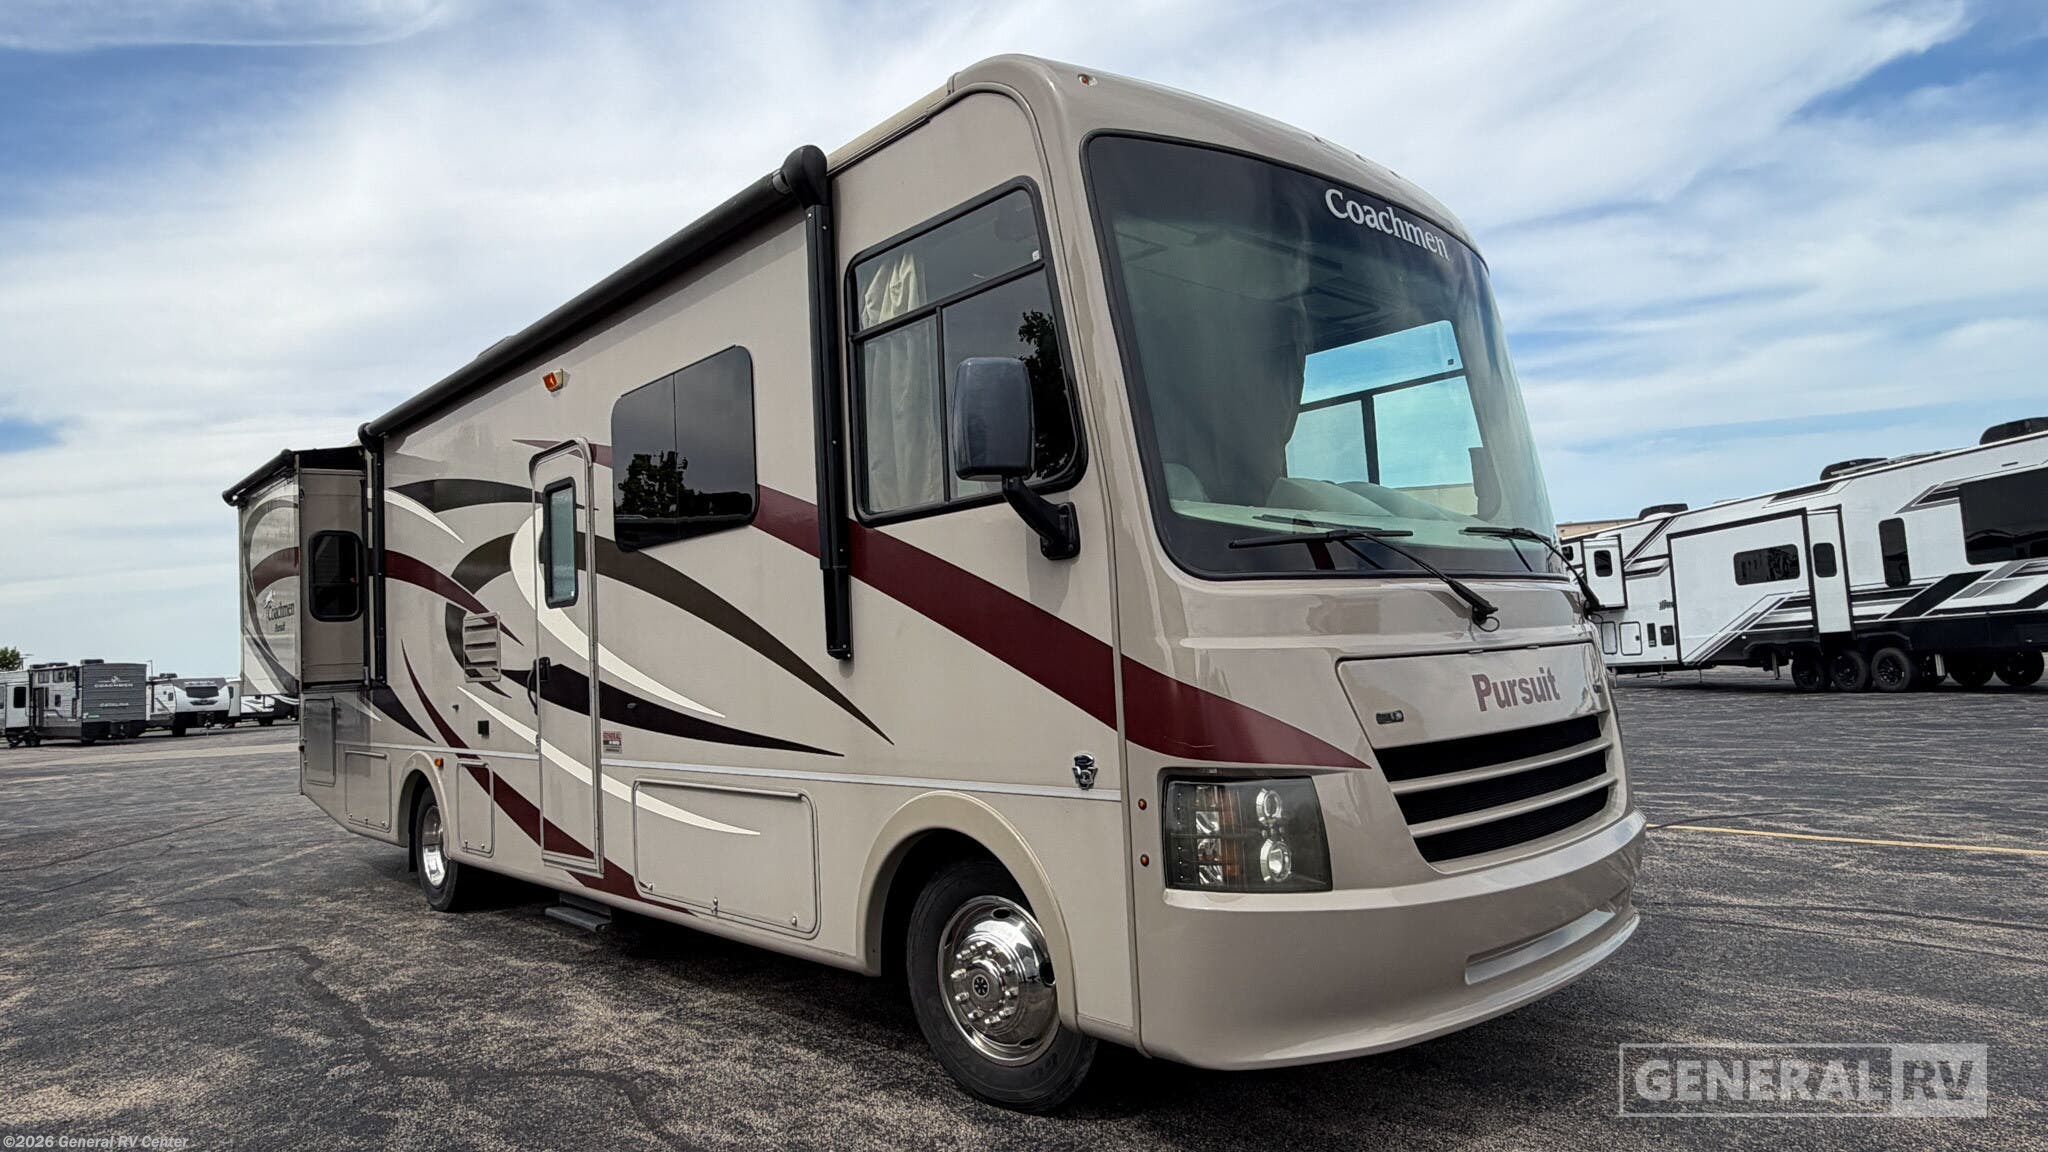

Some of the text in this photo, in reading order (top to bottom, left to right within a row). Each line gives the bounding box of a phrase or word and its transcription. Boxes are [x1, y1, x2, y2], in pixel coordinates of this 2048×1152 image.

[1325, 188, 1450, 261] Coachmen
[267, 601, 295, 621] Coachmen
[1472, 666, 1560, 712] Pursuit
